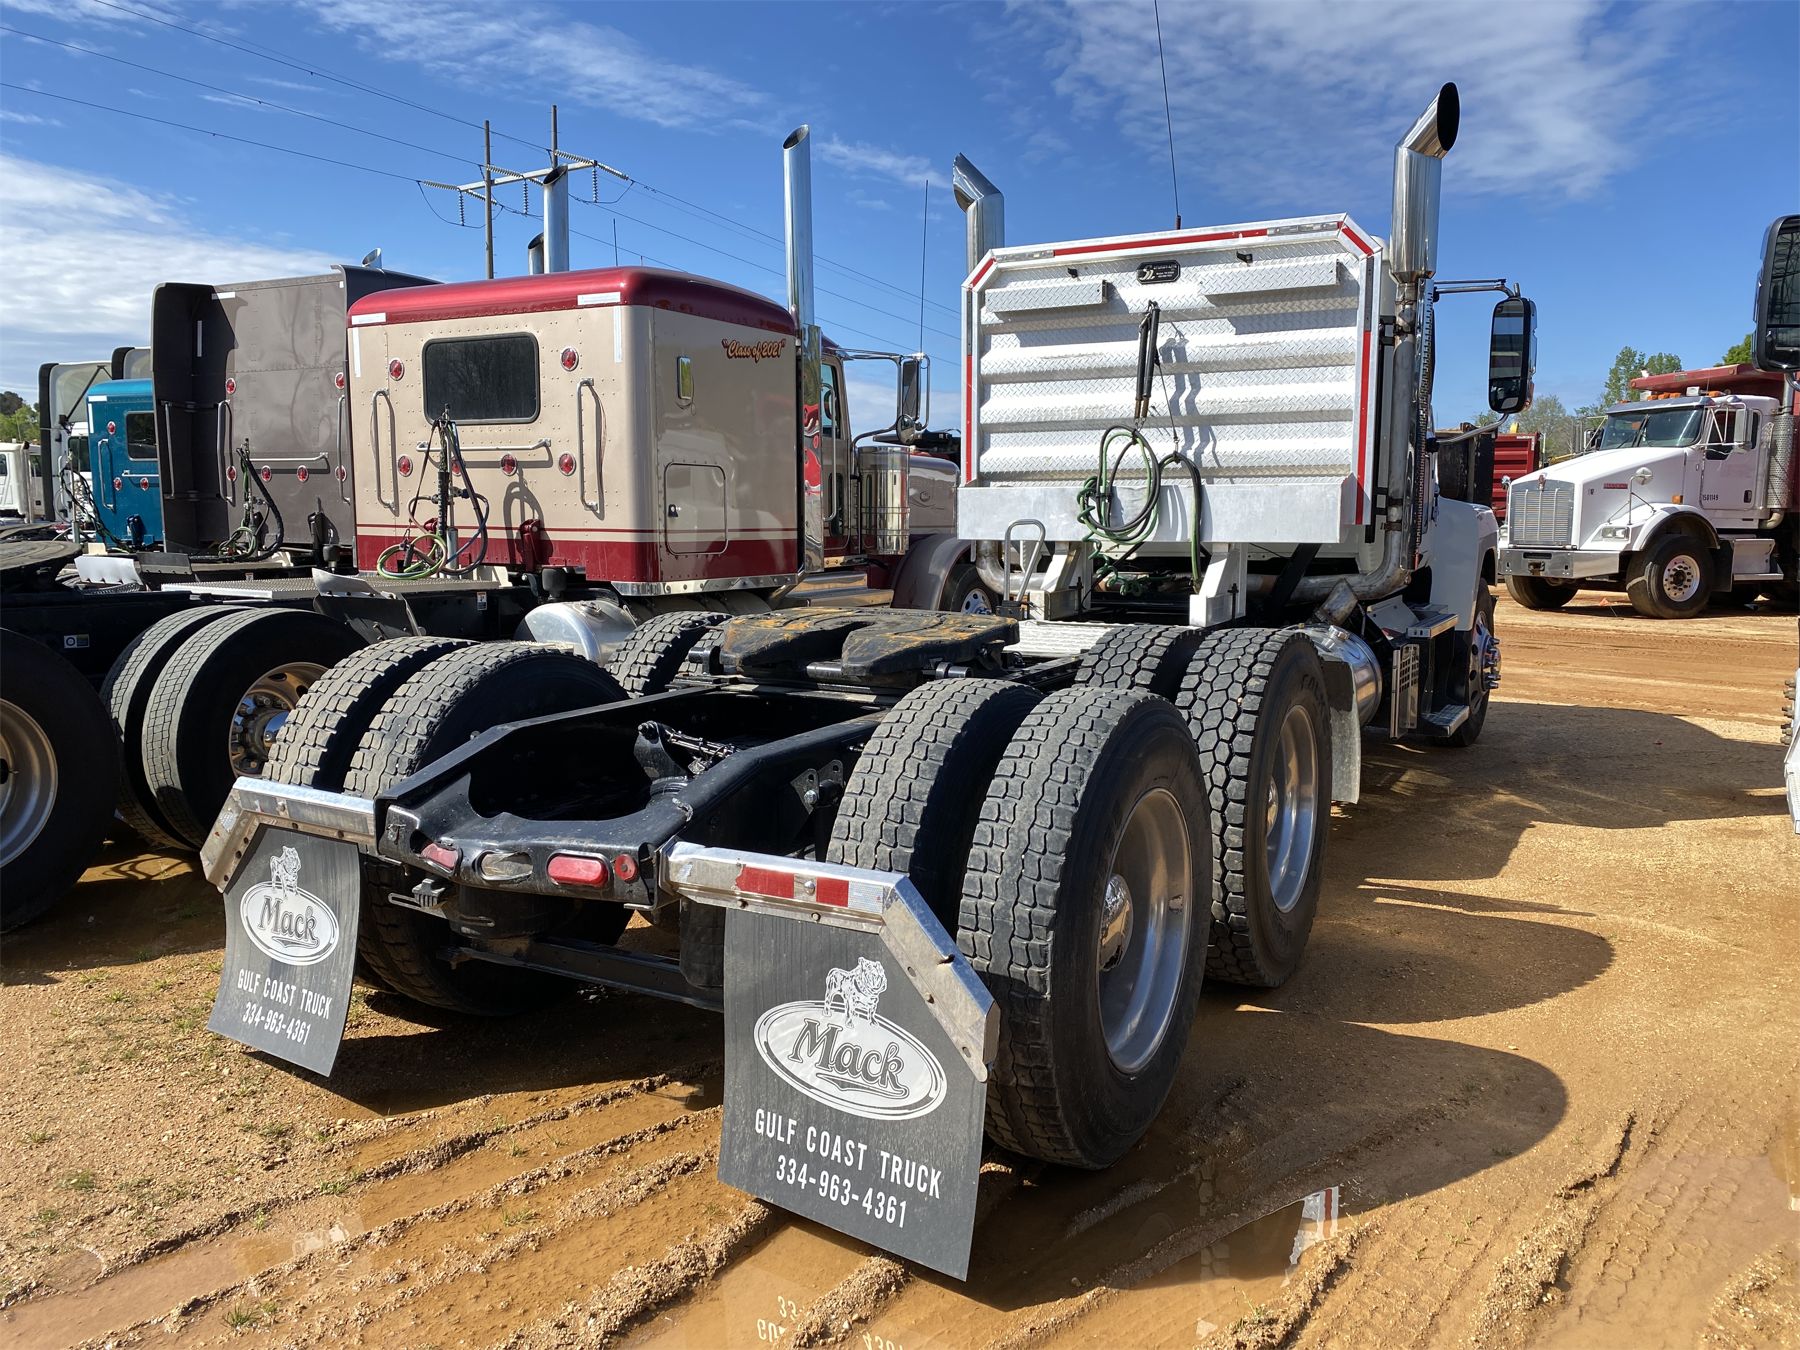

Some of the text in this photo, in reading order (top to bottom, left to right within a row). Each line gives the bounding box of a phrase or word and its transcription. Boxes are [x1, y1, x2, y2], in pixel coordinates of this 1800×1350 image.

[751, 341, 761, 363] of
[257, 895, 319, 949] Mack
[238, 968, 332, 1019] GULF COAST TRUCK
[242, 1002, 311, 1045] 334-963-4361
[788, 1018, 909, 1098] Mack
[755, 1108, 942, 1199] GULF COAST TRUCK
[776, 1155, 907, 1228] 334-963-4361
